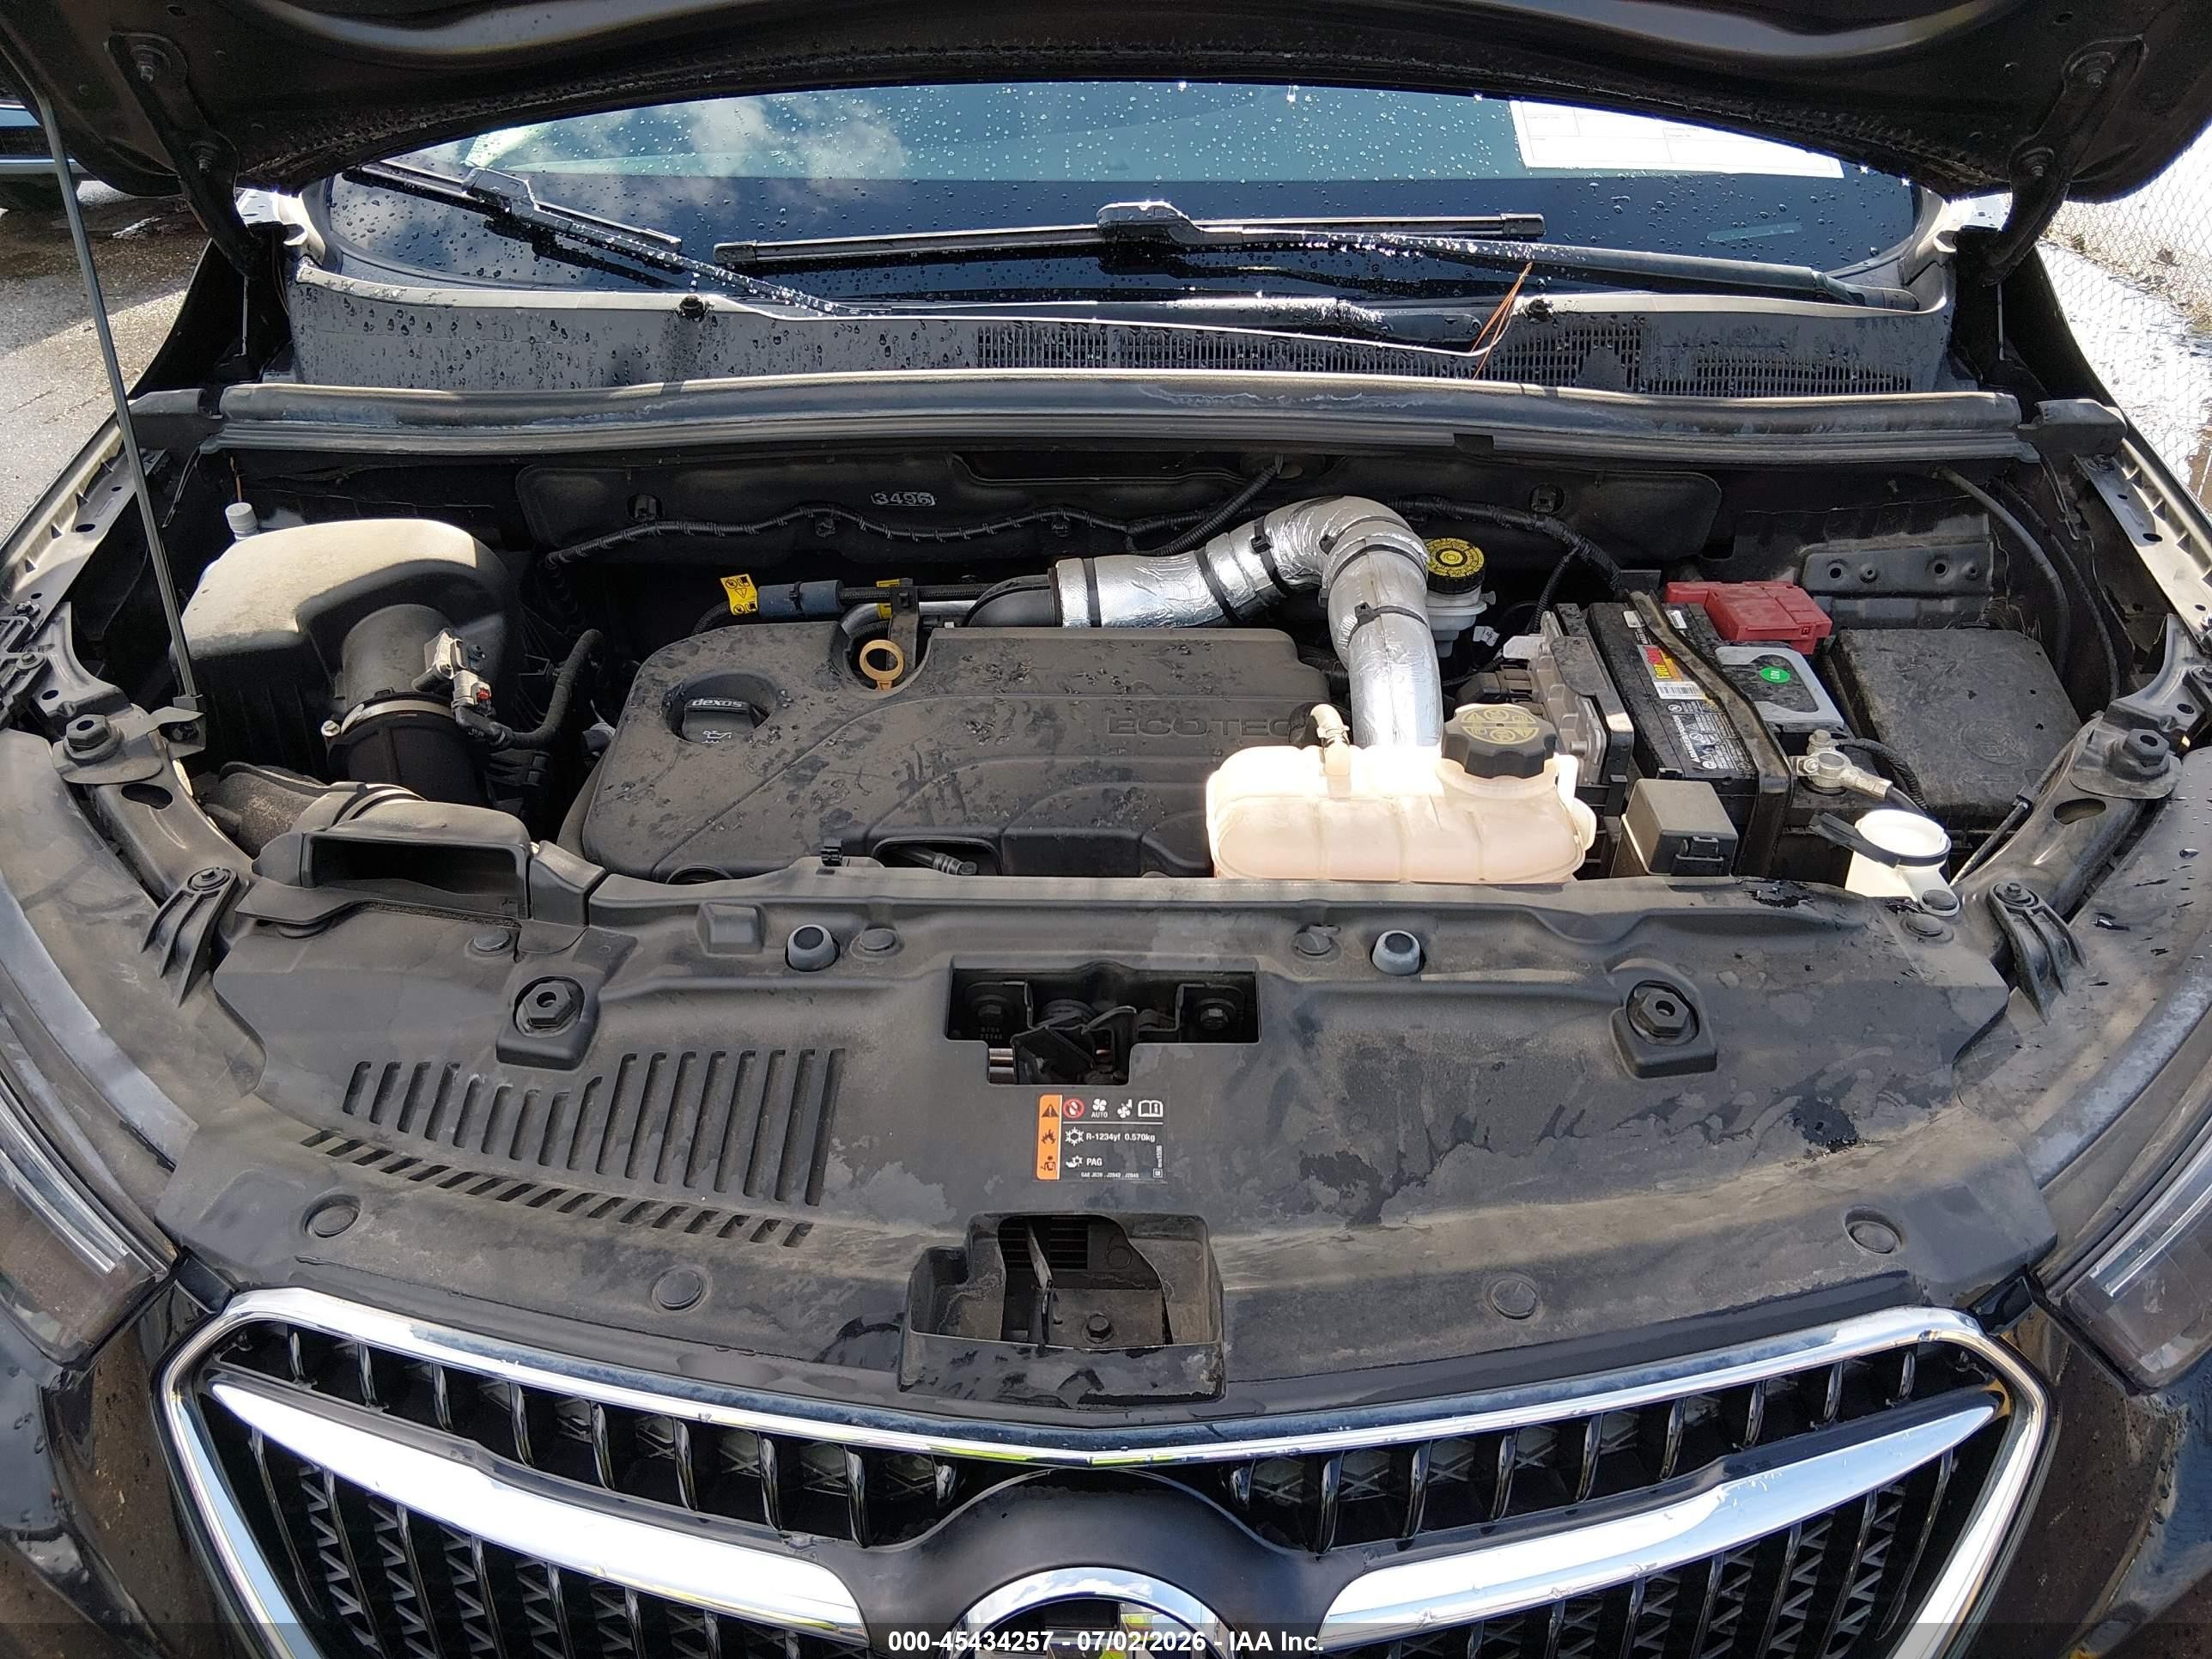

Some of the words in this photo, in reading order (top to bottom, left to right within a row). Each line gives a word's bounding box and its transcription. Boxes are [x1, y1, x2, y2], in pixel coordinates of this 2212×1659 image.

[874, 492, 932, 505] 3496
[692, 698, 743, 708] dexos
[1086, 1133, 1121, 1142] R-1234yf
[1086, 1158, 1103, 1166] PAG
